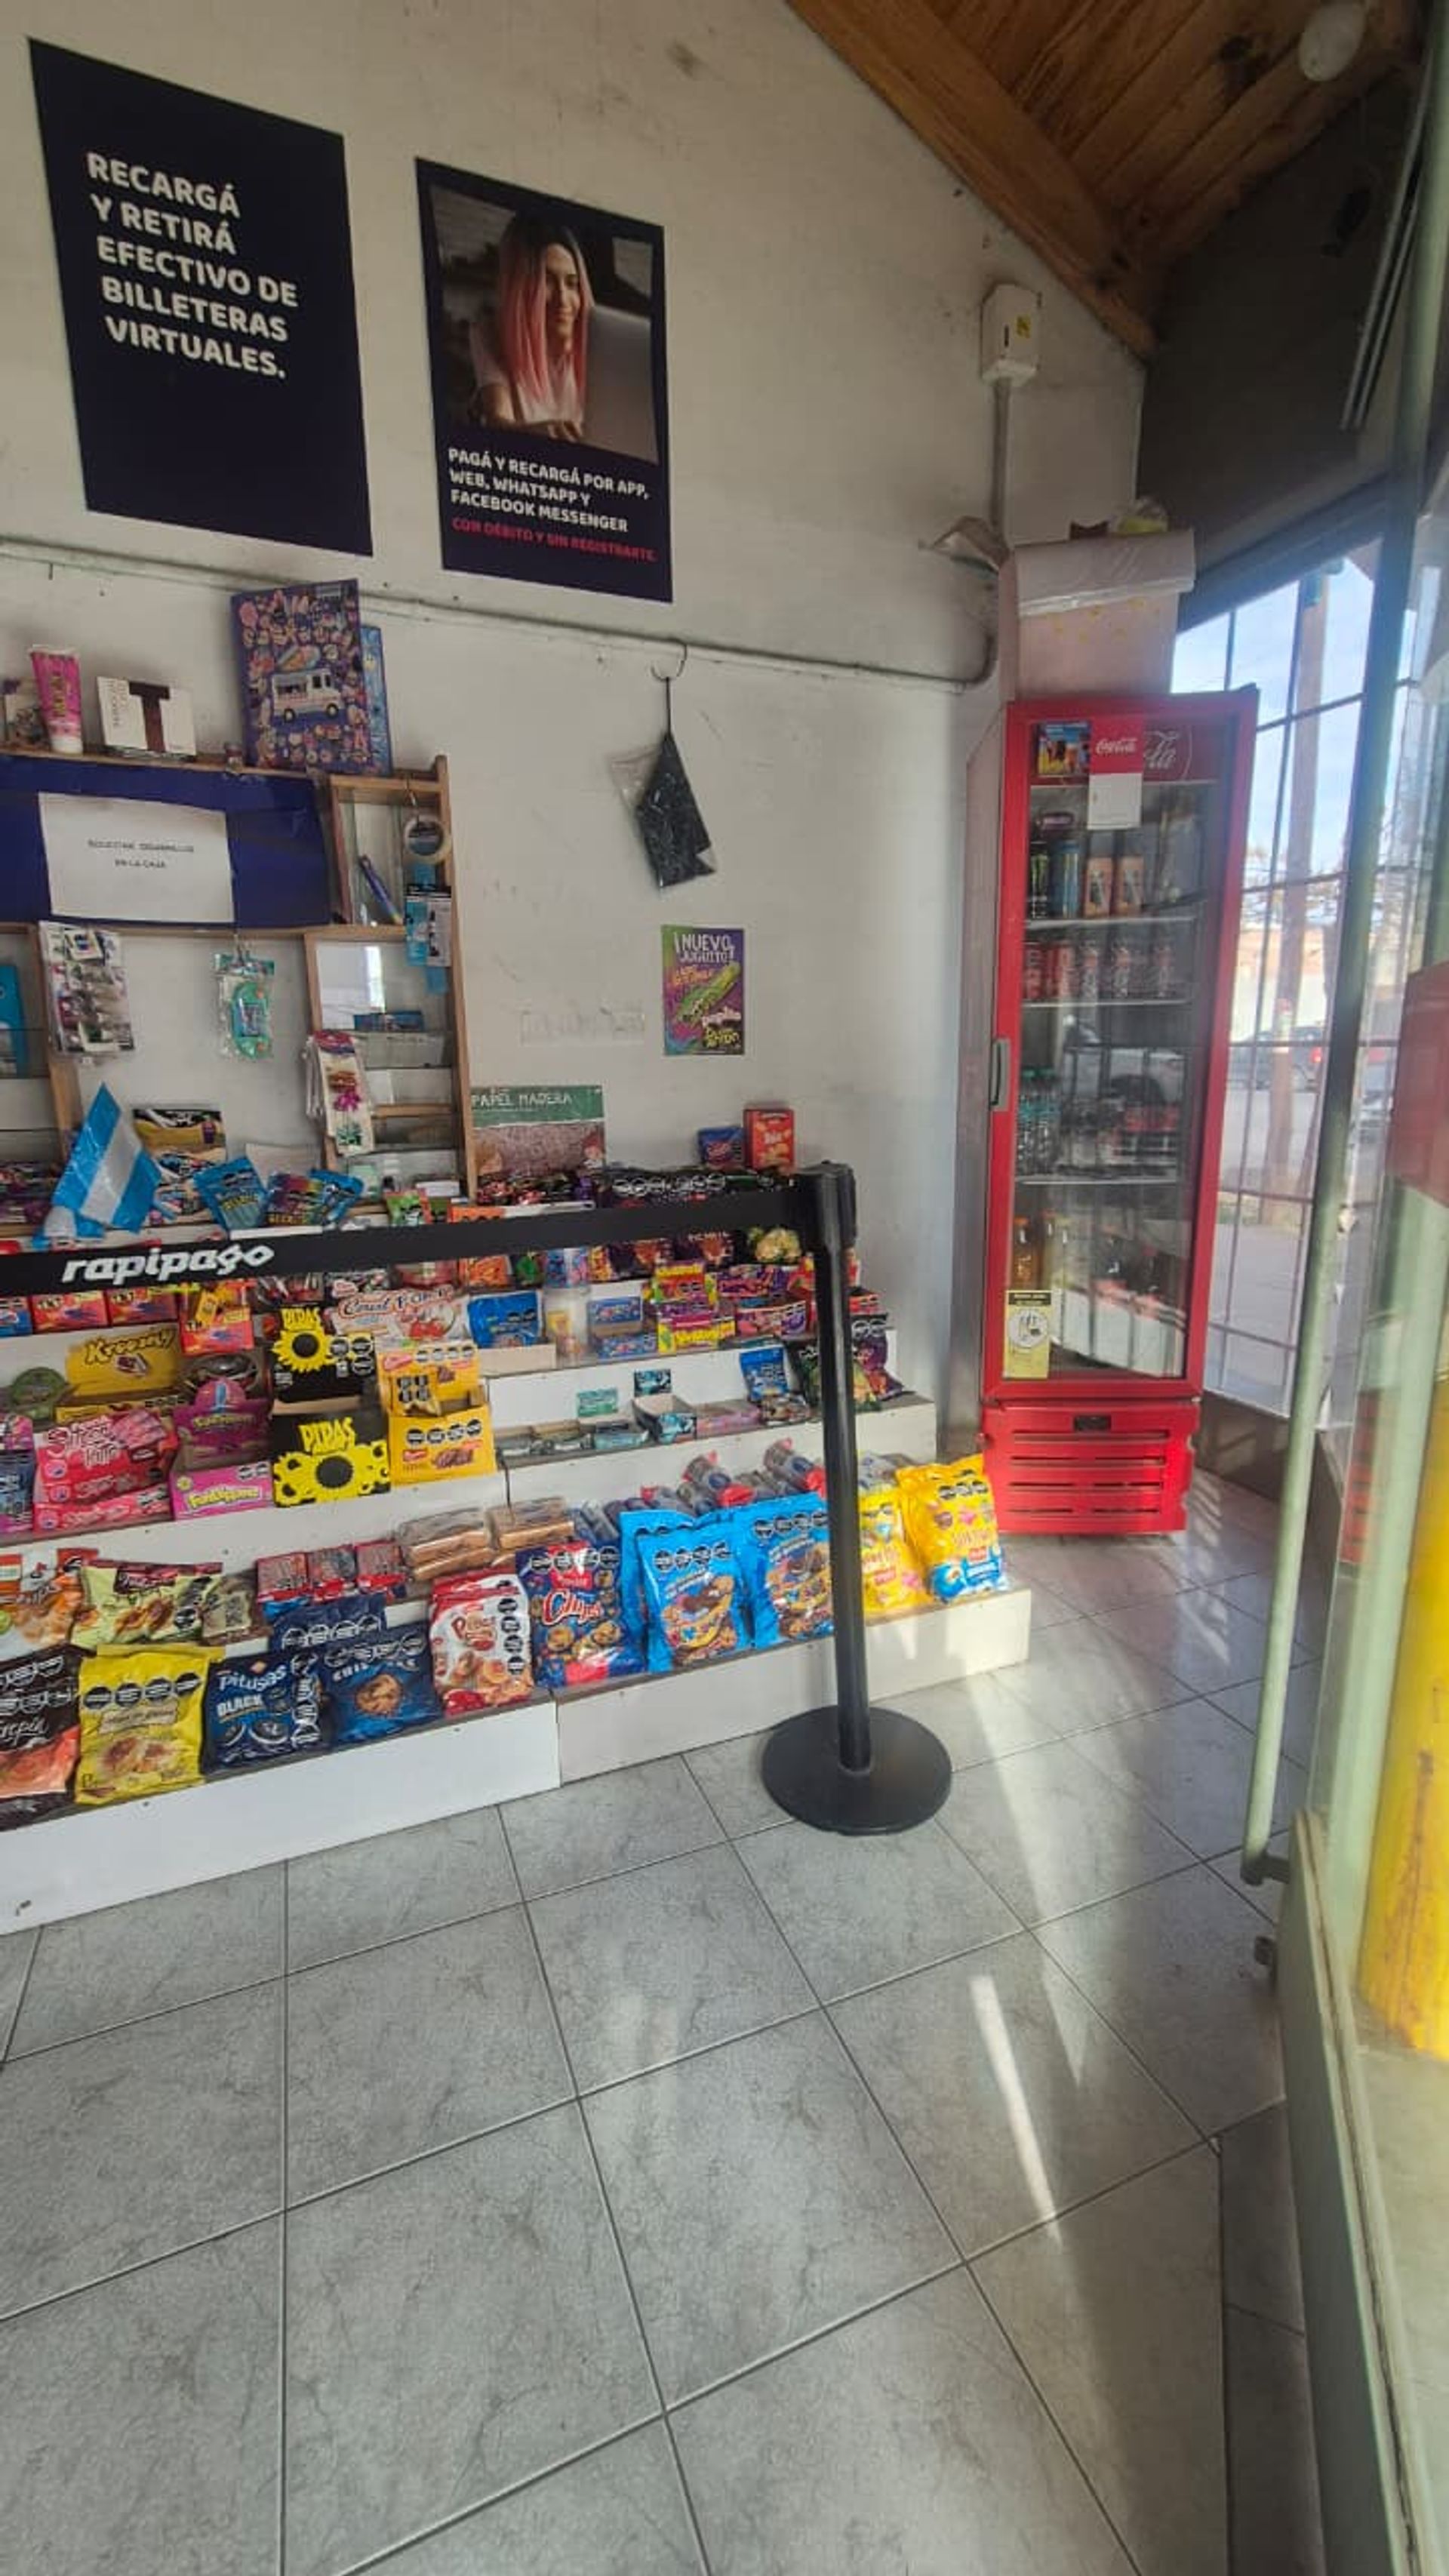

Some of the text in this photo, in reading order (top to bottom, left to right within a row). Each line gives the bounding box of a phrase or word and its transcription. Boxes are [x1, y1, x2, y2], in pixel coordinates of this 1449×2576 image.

[87, 152, 240, 219] RECARGÁ
[91, 193, 236, 255] Y RETIRÁ
[97, 235, 299, 307] EFECTIVO DE
[101, 275, 288, 342] BILLETERAS
[104, 315, 286, 380] VIRTUALES.
[448, 448, 650, 500] PAGÁ Y RECARGÁ POR APP,
[449, 469, 592, 506] WEB, WHATSAPP Y
[451, 489, 629, 533] FACEBOOK MESSENGER
[471, 1092, 573, 1108] PAPEL MADERA
[62, 1244, 275, 1285] rapipago
[217, 1692, 264, 1719] BLACK
